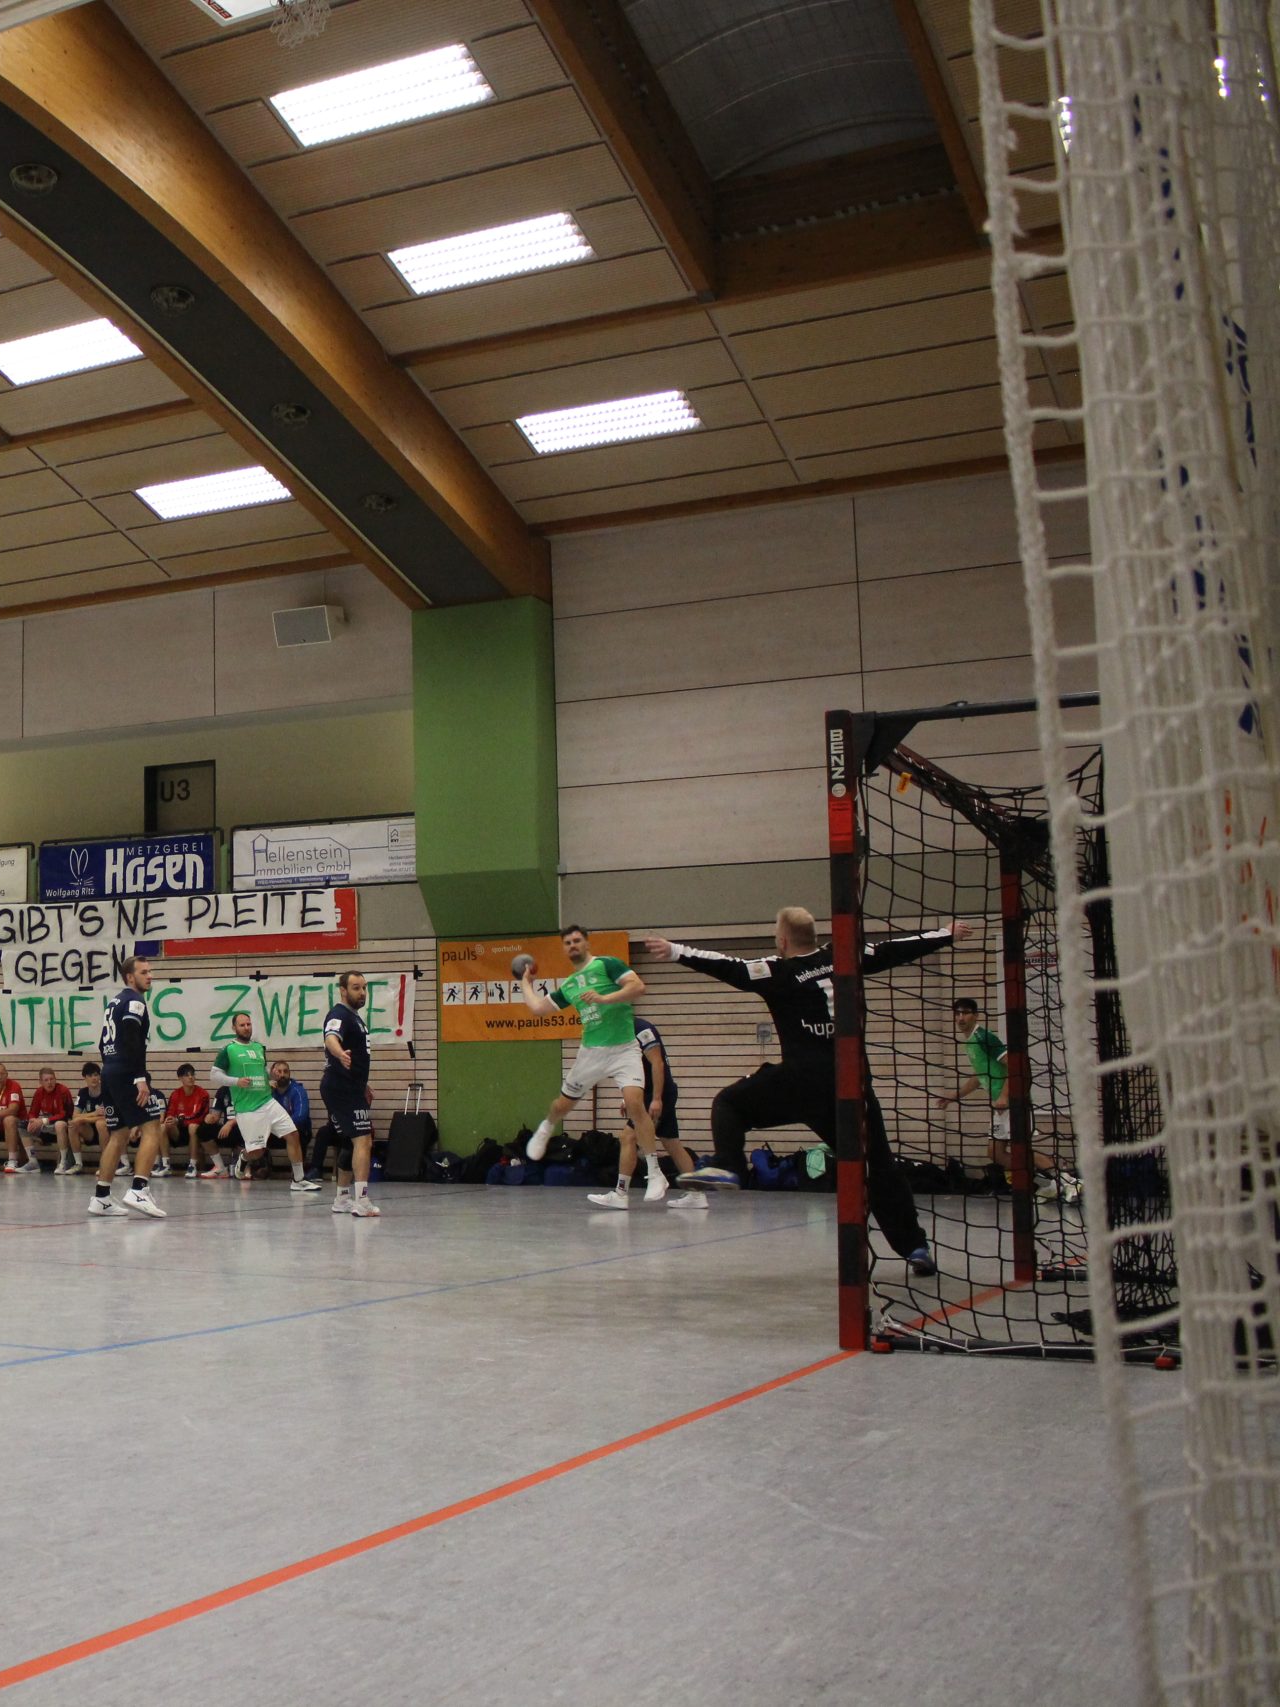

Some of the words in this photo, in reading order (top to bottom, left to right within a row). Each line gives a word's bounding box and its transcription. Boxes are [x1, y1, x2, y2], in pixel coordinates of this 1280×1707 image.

[830, 728, 845, 780] BENZ
[161, 779, 190, 802] U3
[126, 842, 204, 856] METZGEREI
[253, 839, 343, 863] Hellenstein
[105, 848, 205, 895] Hasen
[316, 861, 351, 874] GmbH
[45, 888, 80, 899] Wolfgang
[81, 887, 95, 896] Ritz
[184, 890, 325, 933] PLEITE
[442, 946, 477, 966] pauls
[209, 974, 406, 1041] ZWEIE!
[485, 1015, 582, 1030] www.pauls53.de
[801, 1018, 835, 1039] hüp
